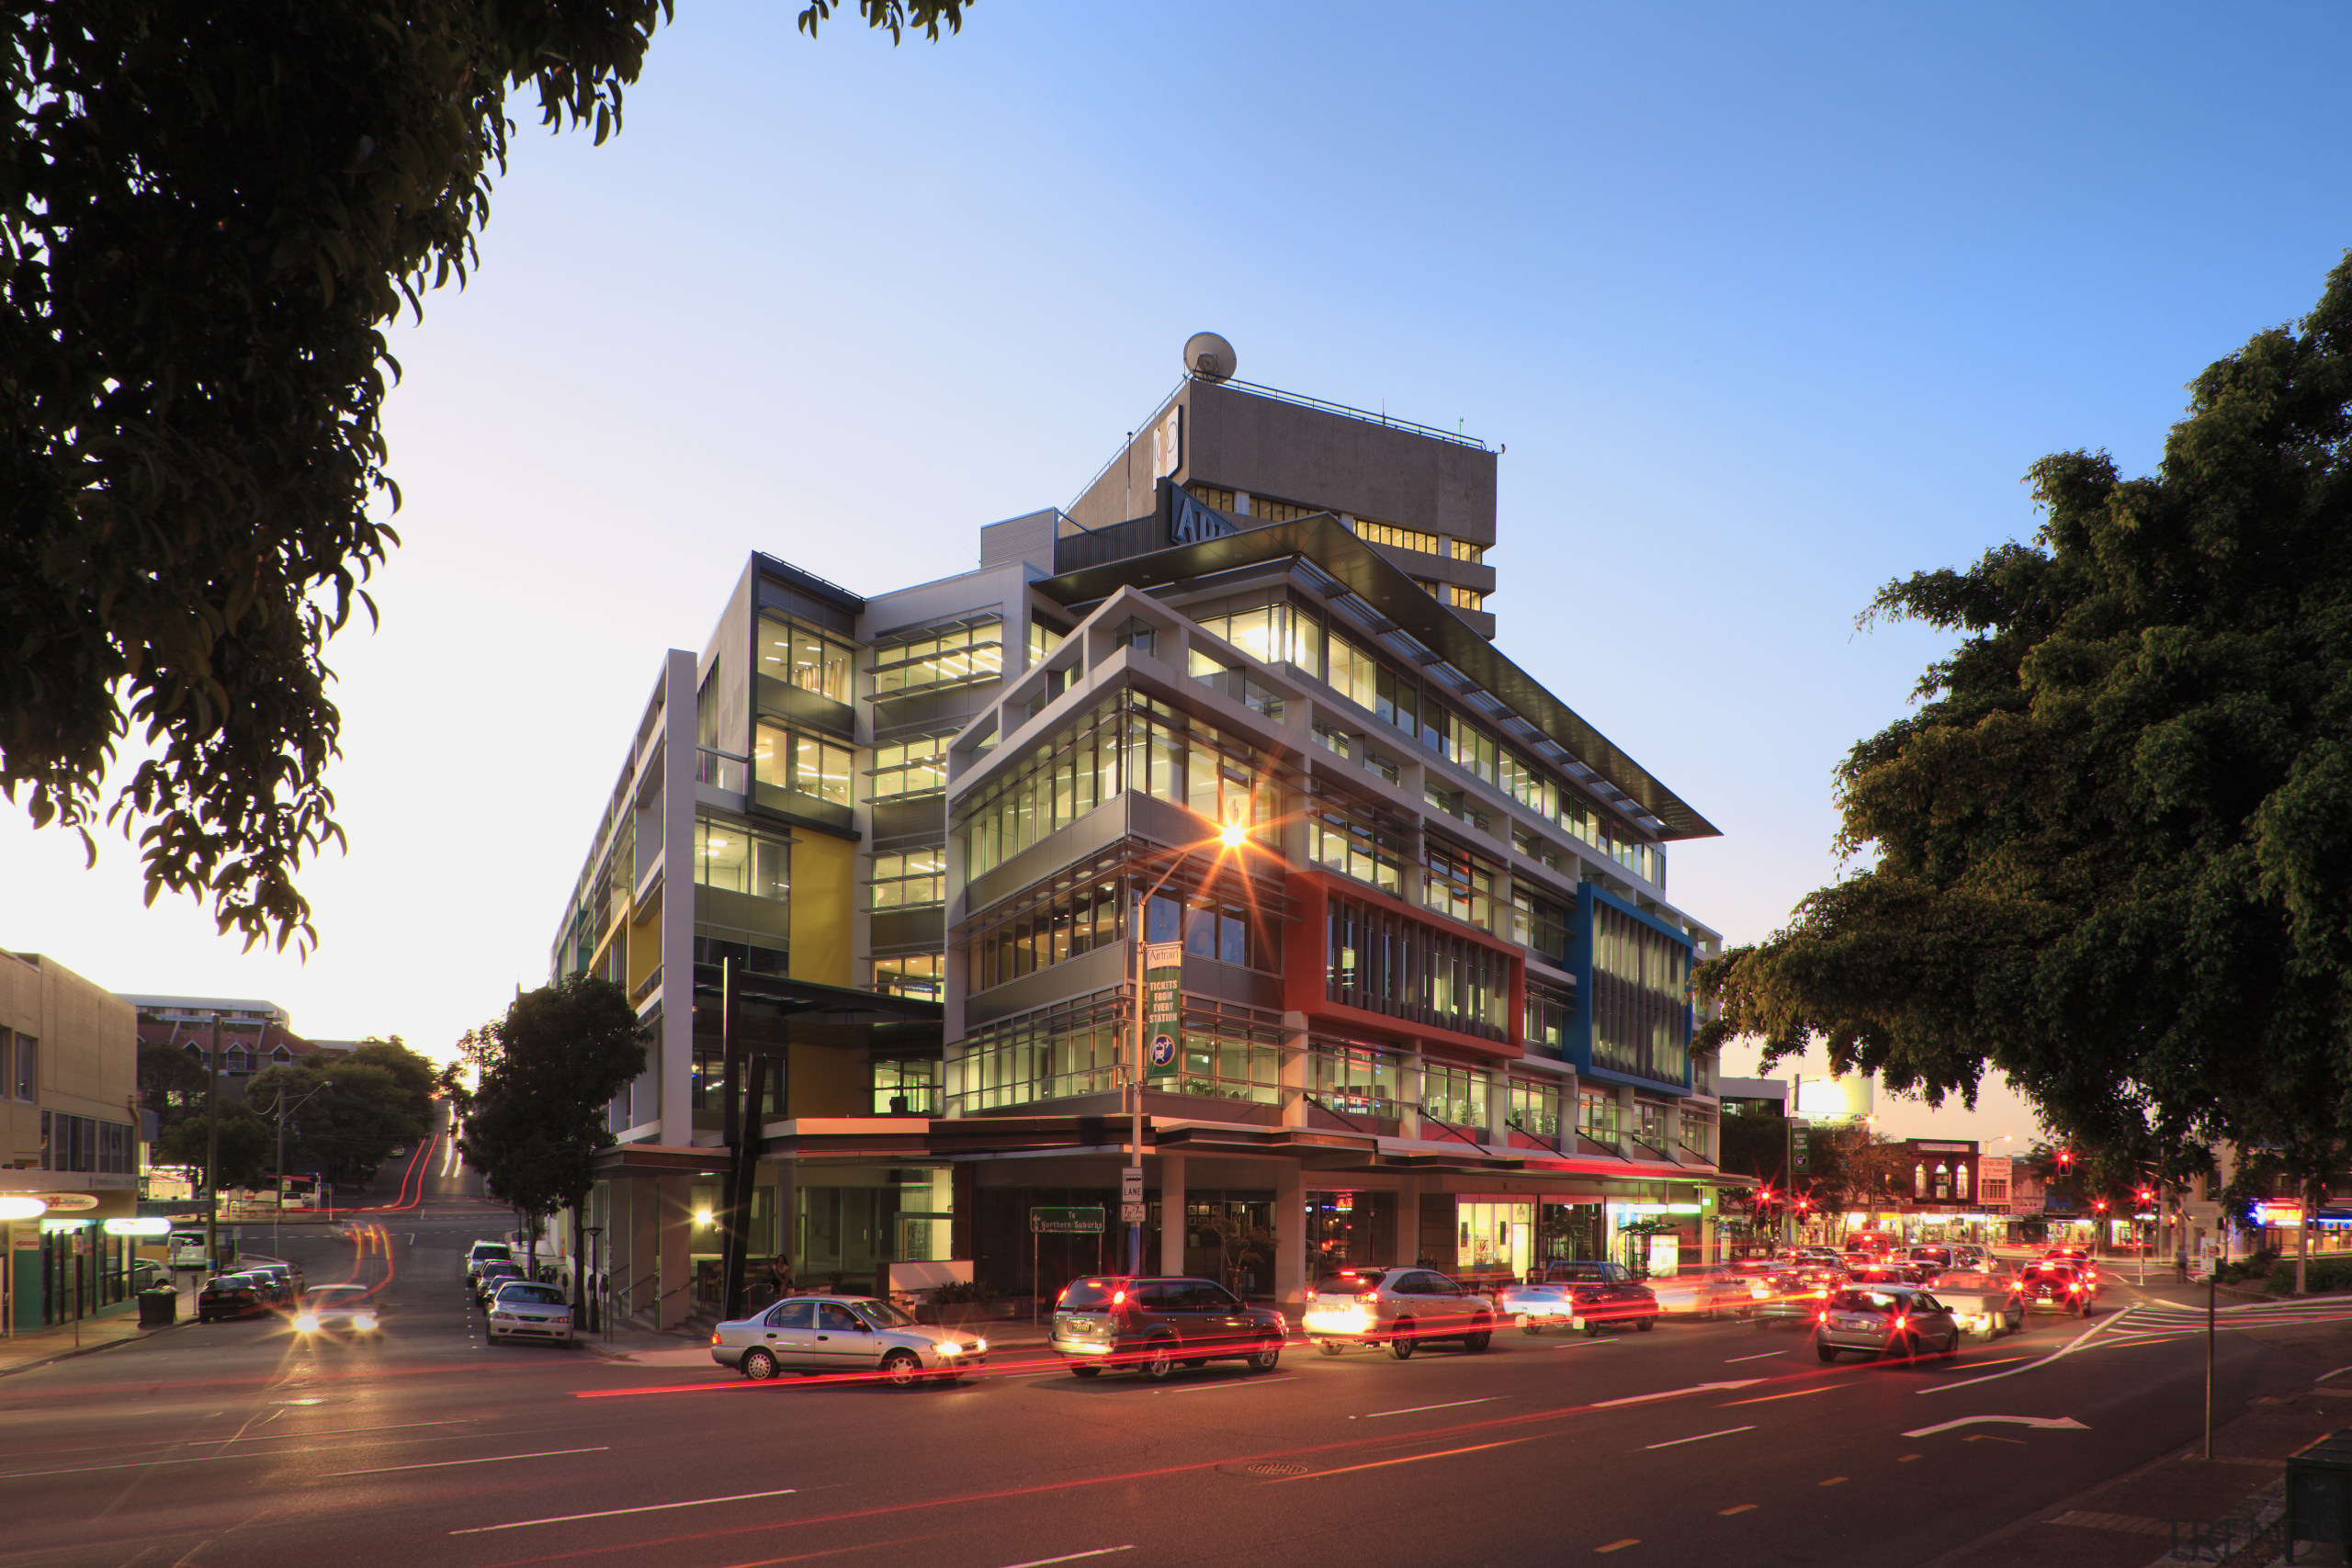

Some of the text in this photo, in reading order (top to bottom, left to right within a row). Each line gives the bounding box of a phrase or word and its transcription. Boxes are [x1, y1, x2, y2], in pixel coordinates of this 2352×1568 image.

[1149, 949, 1178, 961] Airtrain
[1149, 980, 1177, 991] TICKETS
[1154, 991, 1173, 1001] FROM
[1153, 1002, 1173, 1012] EVERY
[1149, 1012, 1177, 1023] STATION
[1124, 1188, 1141, 1196] LANE
[1068, 1211, 1076, 1219] To
